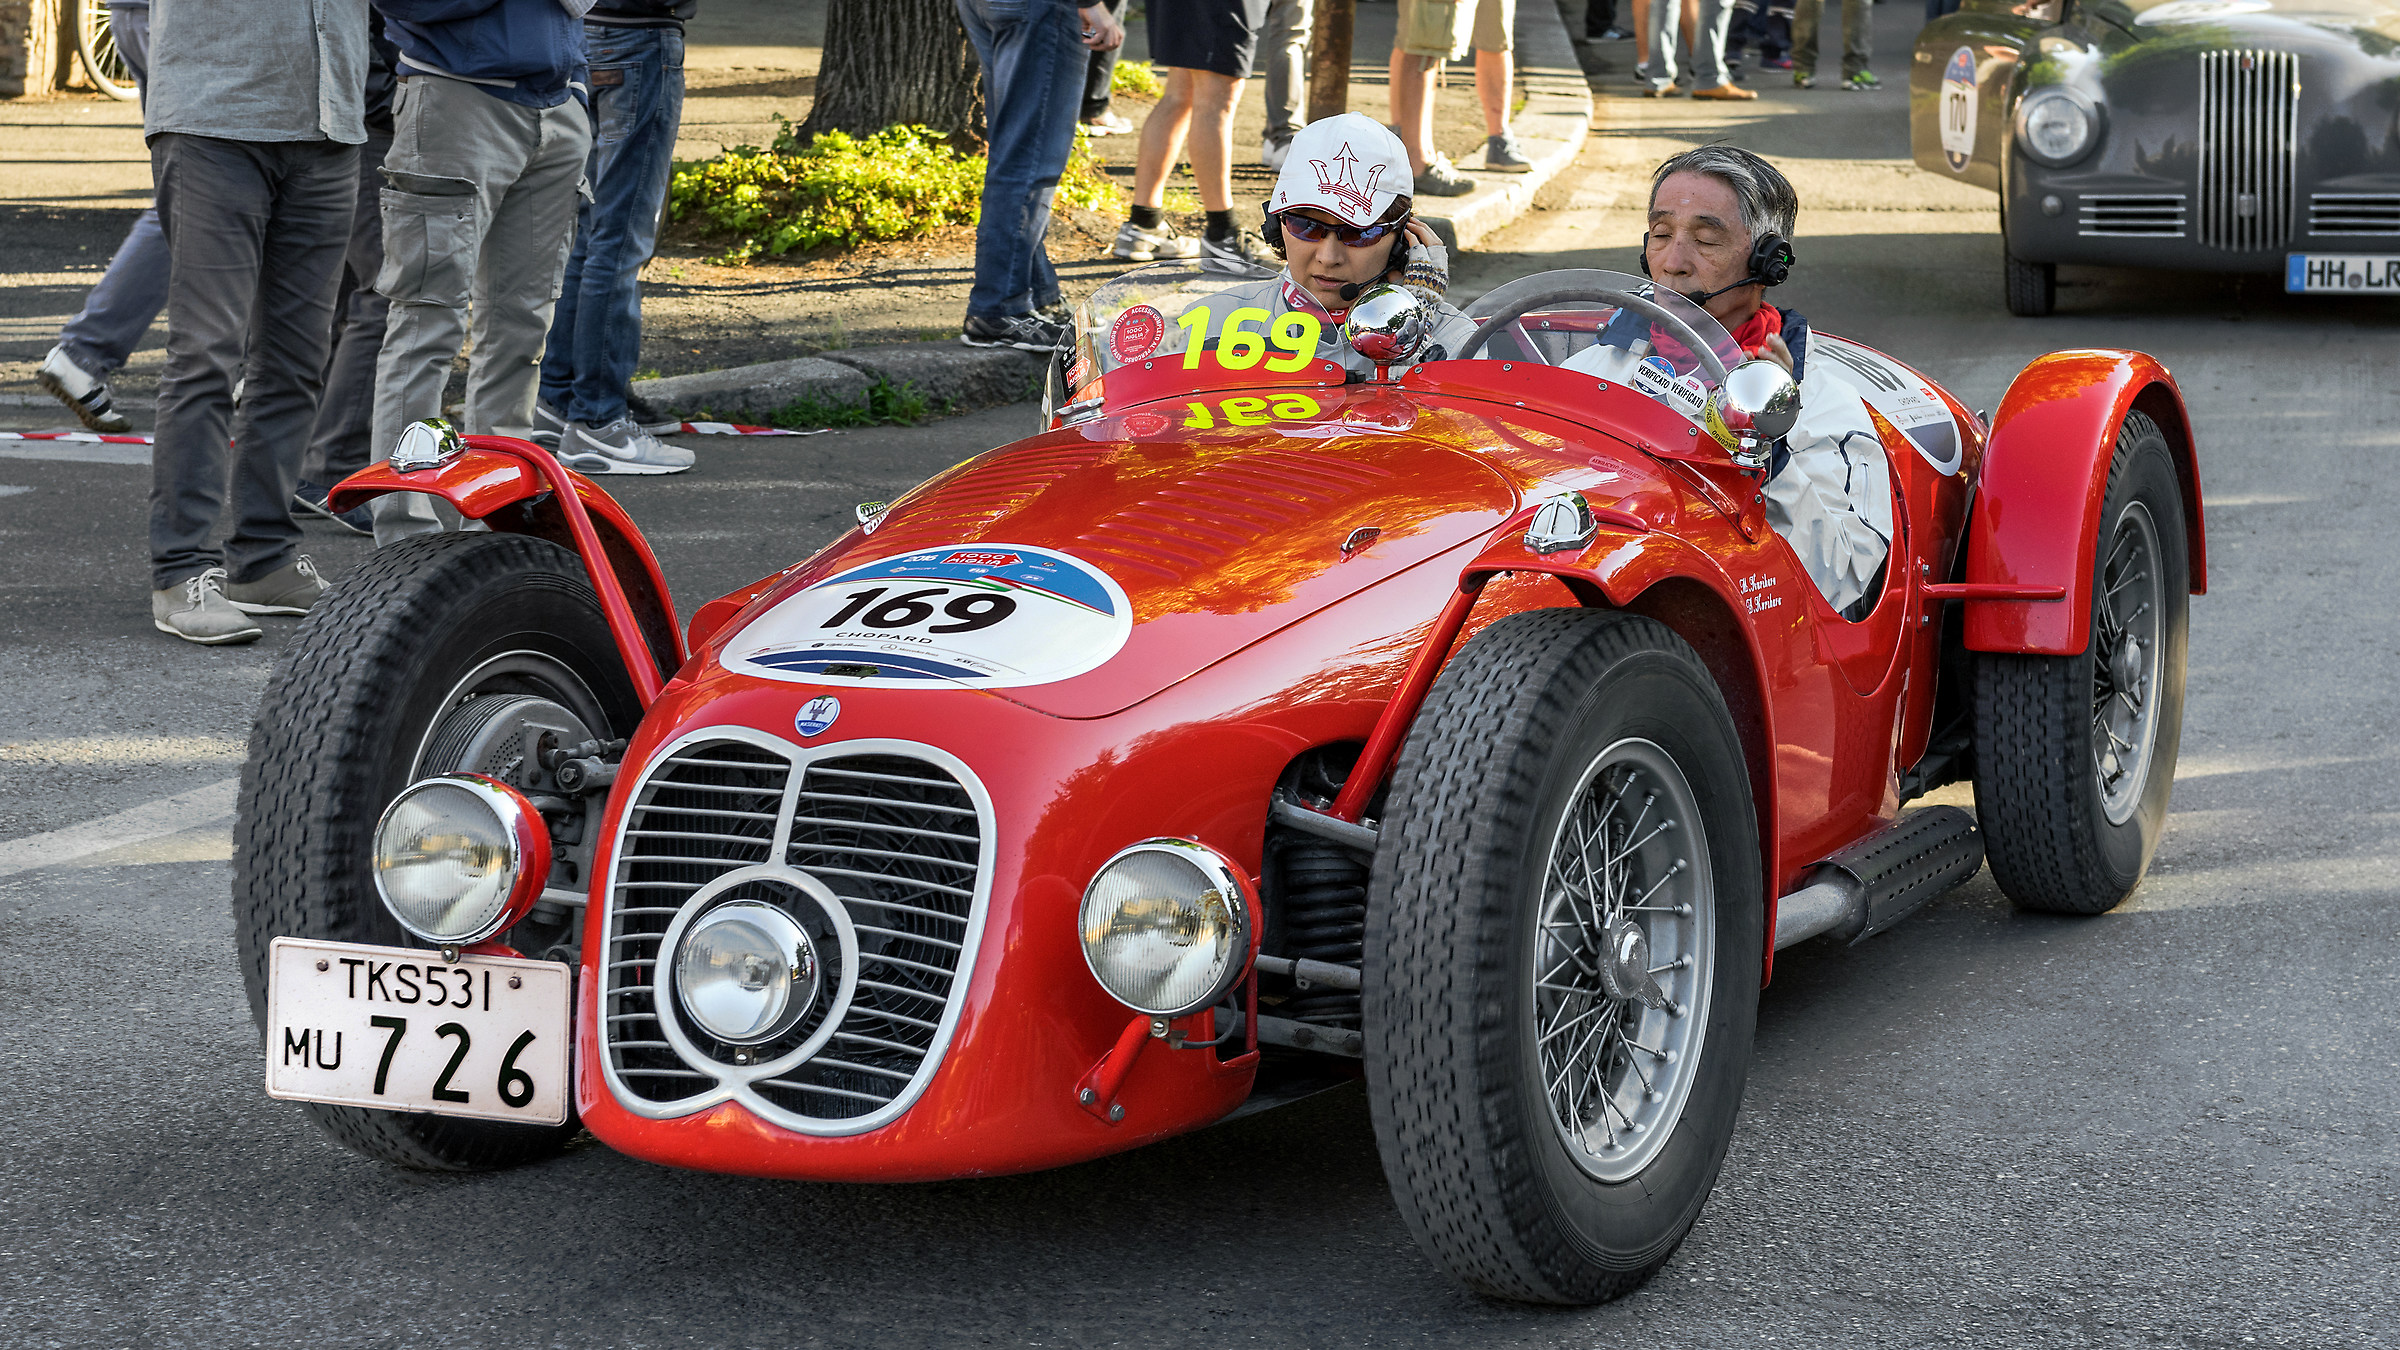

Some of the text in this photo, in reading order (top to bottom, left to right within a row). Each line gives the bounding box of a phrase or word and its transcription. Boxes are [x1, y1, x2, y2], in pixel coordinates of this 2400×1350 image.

[1949, 93, 1967, 133] 170
[2307, 260, 2346, 288] HH
[1176, 305, 1322, 373] 169
[1637, 364, 1671, 389] VERIFICATO
[1670, 381, 1704, 409] VERIFICATO
[946, 558, 1002, 566] MIGLIA
[819, 588, 1017, 634] 169
[835, 632, 933, 644] CHOPARD
[284, 1014, 537, 1108] MU 726
